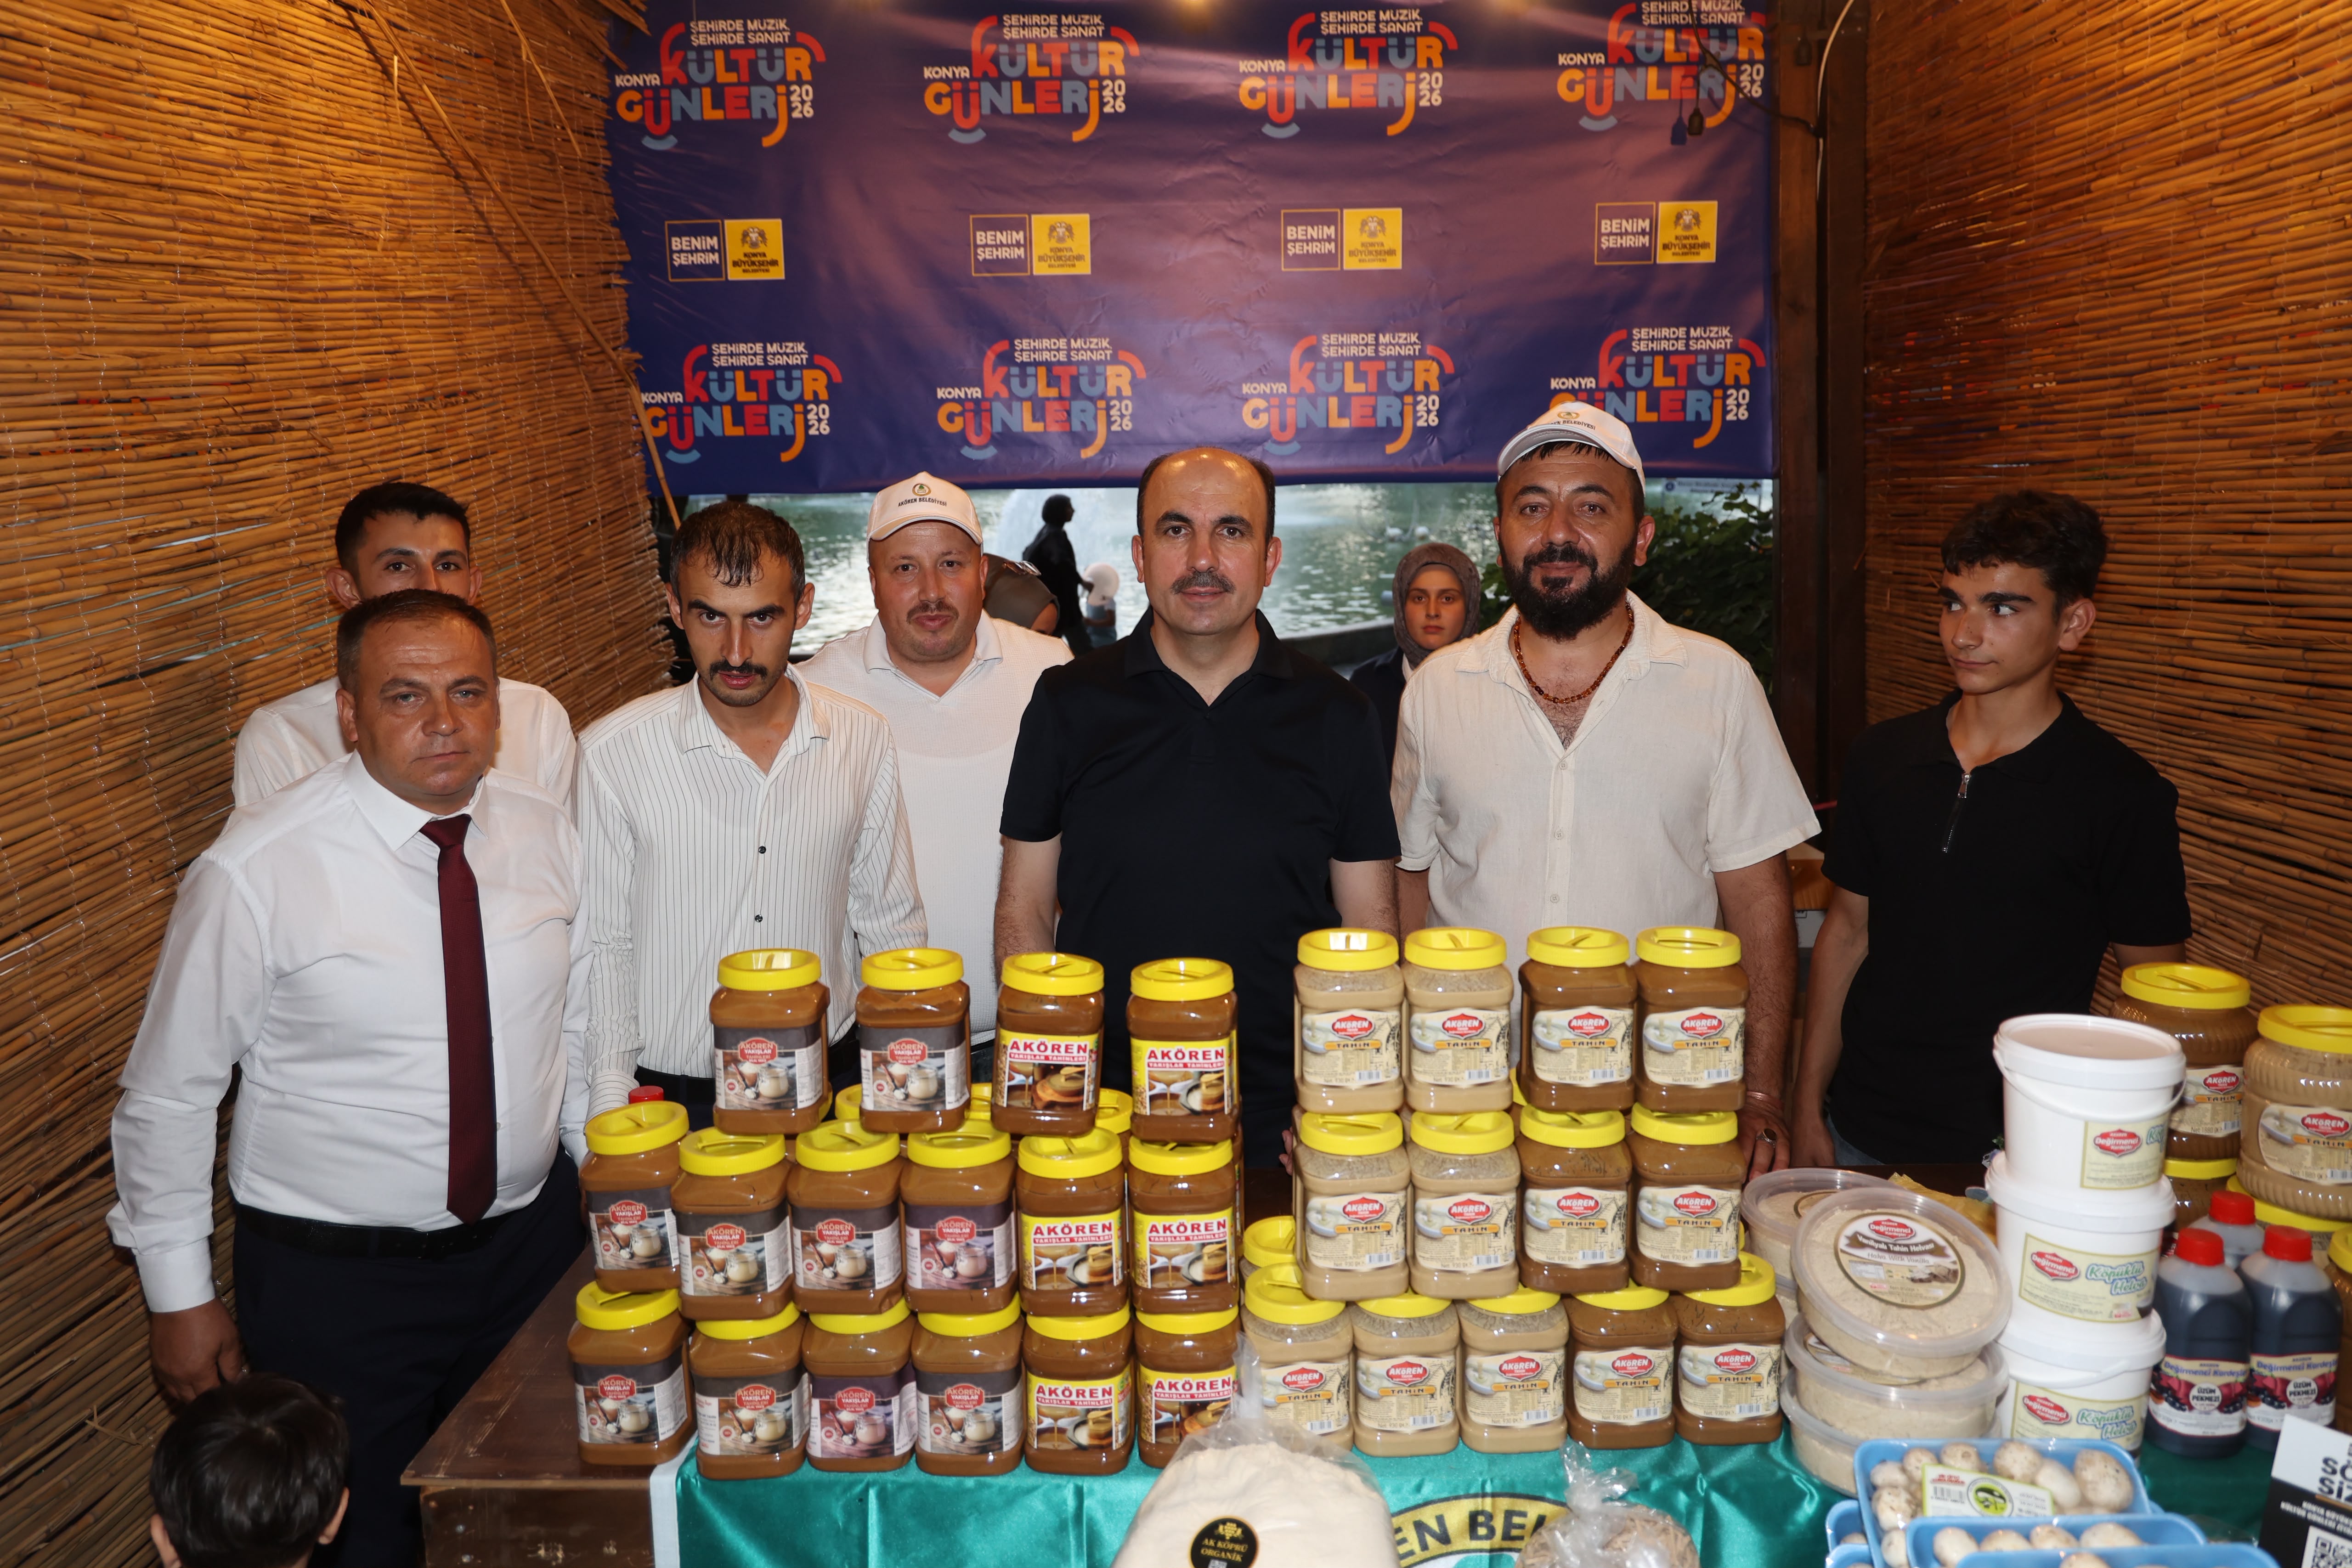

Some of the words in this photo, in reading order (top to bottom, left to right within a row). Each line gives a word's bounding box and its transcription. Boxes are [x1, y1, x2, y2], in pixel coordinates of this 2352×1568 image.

[1003, 14, 1058, 27] ŞEHİRDE
[1321, 11, 1376, 23] ŞEHİRDE
[1701, 11, 1745, 24] SANAT
[690, 20, 744, 34] ŞEHİRDE
[1003, 27, 1058, 39] ŞEHİRDE
[1061, 26, 1104, 38] SANAT
[1321, 23, 1376, 35] ŞEHİRDE
[1379, 21, 1423, 34] SANAT
[1608, 3, 1764, 64] KÜLTÜR
[691, 33, 745, 46] ŞEHİRDE
[747, 32, 791, 44] SANAT
[972, 15, 1125, 78] KÜLTÜR
[1288, 12, 1443, 71] KÜLTÜR
[660, 22, 812, 85] KÜLTÜR
[1558, 52, 1605, 66] KONYA
[923, 66, 970, 79] KONYA
[1239, 60, 1285, 73] KONYA
[1740, 63, 1764, 81] 20
[615, 73, 661, 87] KONYA
[1102, 79, 1126, 96] 20
[1419, 72, 1443, 89] 20
[789, 85, 814, 102] 20
[1419, 89, 1442, 107] 26
[791, 102, 814, 118] 26
[1103, 96, 1126, 113] 26
[1287, 225, 1335, 240] BENİM
[1601, 218, 1650, 233] BENİM
[671, 236, 718, 250] BENİM
[976, 231, 1024, 245] BENİM
[1601, 234, 1649, 250] ŞEHRİM
[977, 246, 1024, 262] ŞEHRİM
[1287, 241, 1335, 256] ŞEHRİM
[673, 251, 719, 267] ŞEHRİM
[1322, 333, 1375, 345] ŞEHİRDE
[1633, 327, 1686, 340] ŞEHİRDE
[712, 343, 763, 355] ŞEHİRDE
[1014, 338, 1067, 351] ŞEHİRDE
[1322, 345, 1375, 358] ŞEHİRDE
[1379, 345, 1421, 356] SANAT
[1632, 339, 1686, 352] ŞEHİRDE
[1689, 338, 1733, 350] SANAT
[712, 355, 764, 367] ŞEHİRDE
[767, 354, 808, 366] SANAT
[1014, 350, 1067, 363] ŞEHİRDE
[1071, 350, 1112, 361] SANAT
[1289, 335, 1440, 393] KÜLTÜR
[1598, 329, 1751, 388] KÜLTÜR
[683, 344, 829, 402] KÜLTÜR
[983, 339, 1132, 398] KÜLTÜR
[1242, 383, 1287, 394] KONYA
[1550, 377, 1596, 389] KONYA
[642, 392, 683, 404] KONYA
[937, 387, 981, 399] KONYA
[1726, 388, 1750, 405] 20
[1110, 400, 1132, 416] 20
[1416, 395, 1439, 411] 20
[807, 403, 830, 420] 20
[1416, 411, 1439, 427] 26
[1726, 405, 1748, 421] 26
[808, 420, 830, 435] 26
[1110, 416, 1132, 431] 26
[1562, 420, 1595, 430] BELEDİYESİ
[898, 497, 917, 507] AKÖREN
[919, 497, 947, 507] BELEDİYESİ
[740, 1042, 773, 1050] AKÖREN
[1011, 1039, 1088, 1054] AKÖREN
[1148, 1048, 1224, 1060] AKÖREN
[1034, 1222, 1112, 1235] AKÖREN
[1149, 1219, 1227, 1233] AKÖREN
[1870, 1224, 1911, 1233] Değirmenci
[1857, 1235, 1887, 1249] Vanilyalı
[1910, 1243, 1934, 1252] Helvası
[2032, 1254, 2075, 1274] Değirmenci
[2087, 1262, 2143, 1282] Köpüklü
[2113, 1278, 2146, 1294] Helva
[1037, 1385, 1112, 1398] AKÖREN
[1155, 1377, 1231, 1391] AKÖREN
[2024, 1398, 2067, 1419] Değirmenci
[2080, 1408, 2132, 1426] Köpüklü
[1202, 1538, 1216, 1546] AK
[1217, 1540, 1248, 1552] KÖPRÜ
[1200, 1547, 1243, 1562] ORGANİK
